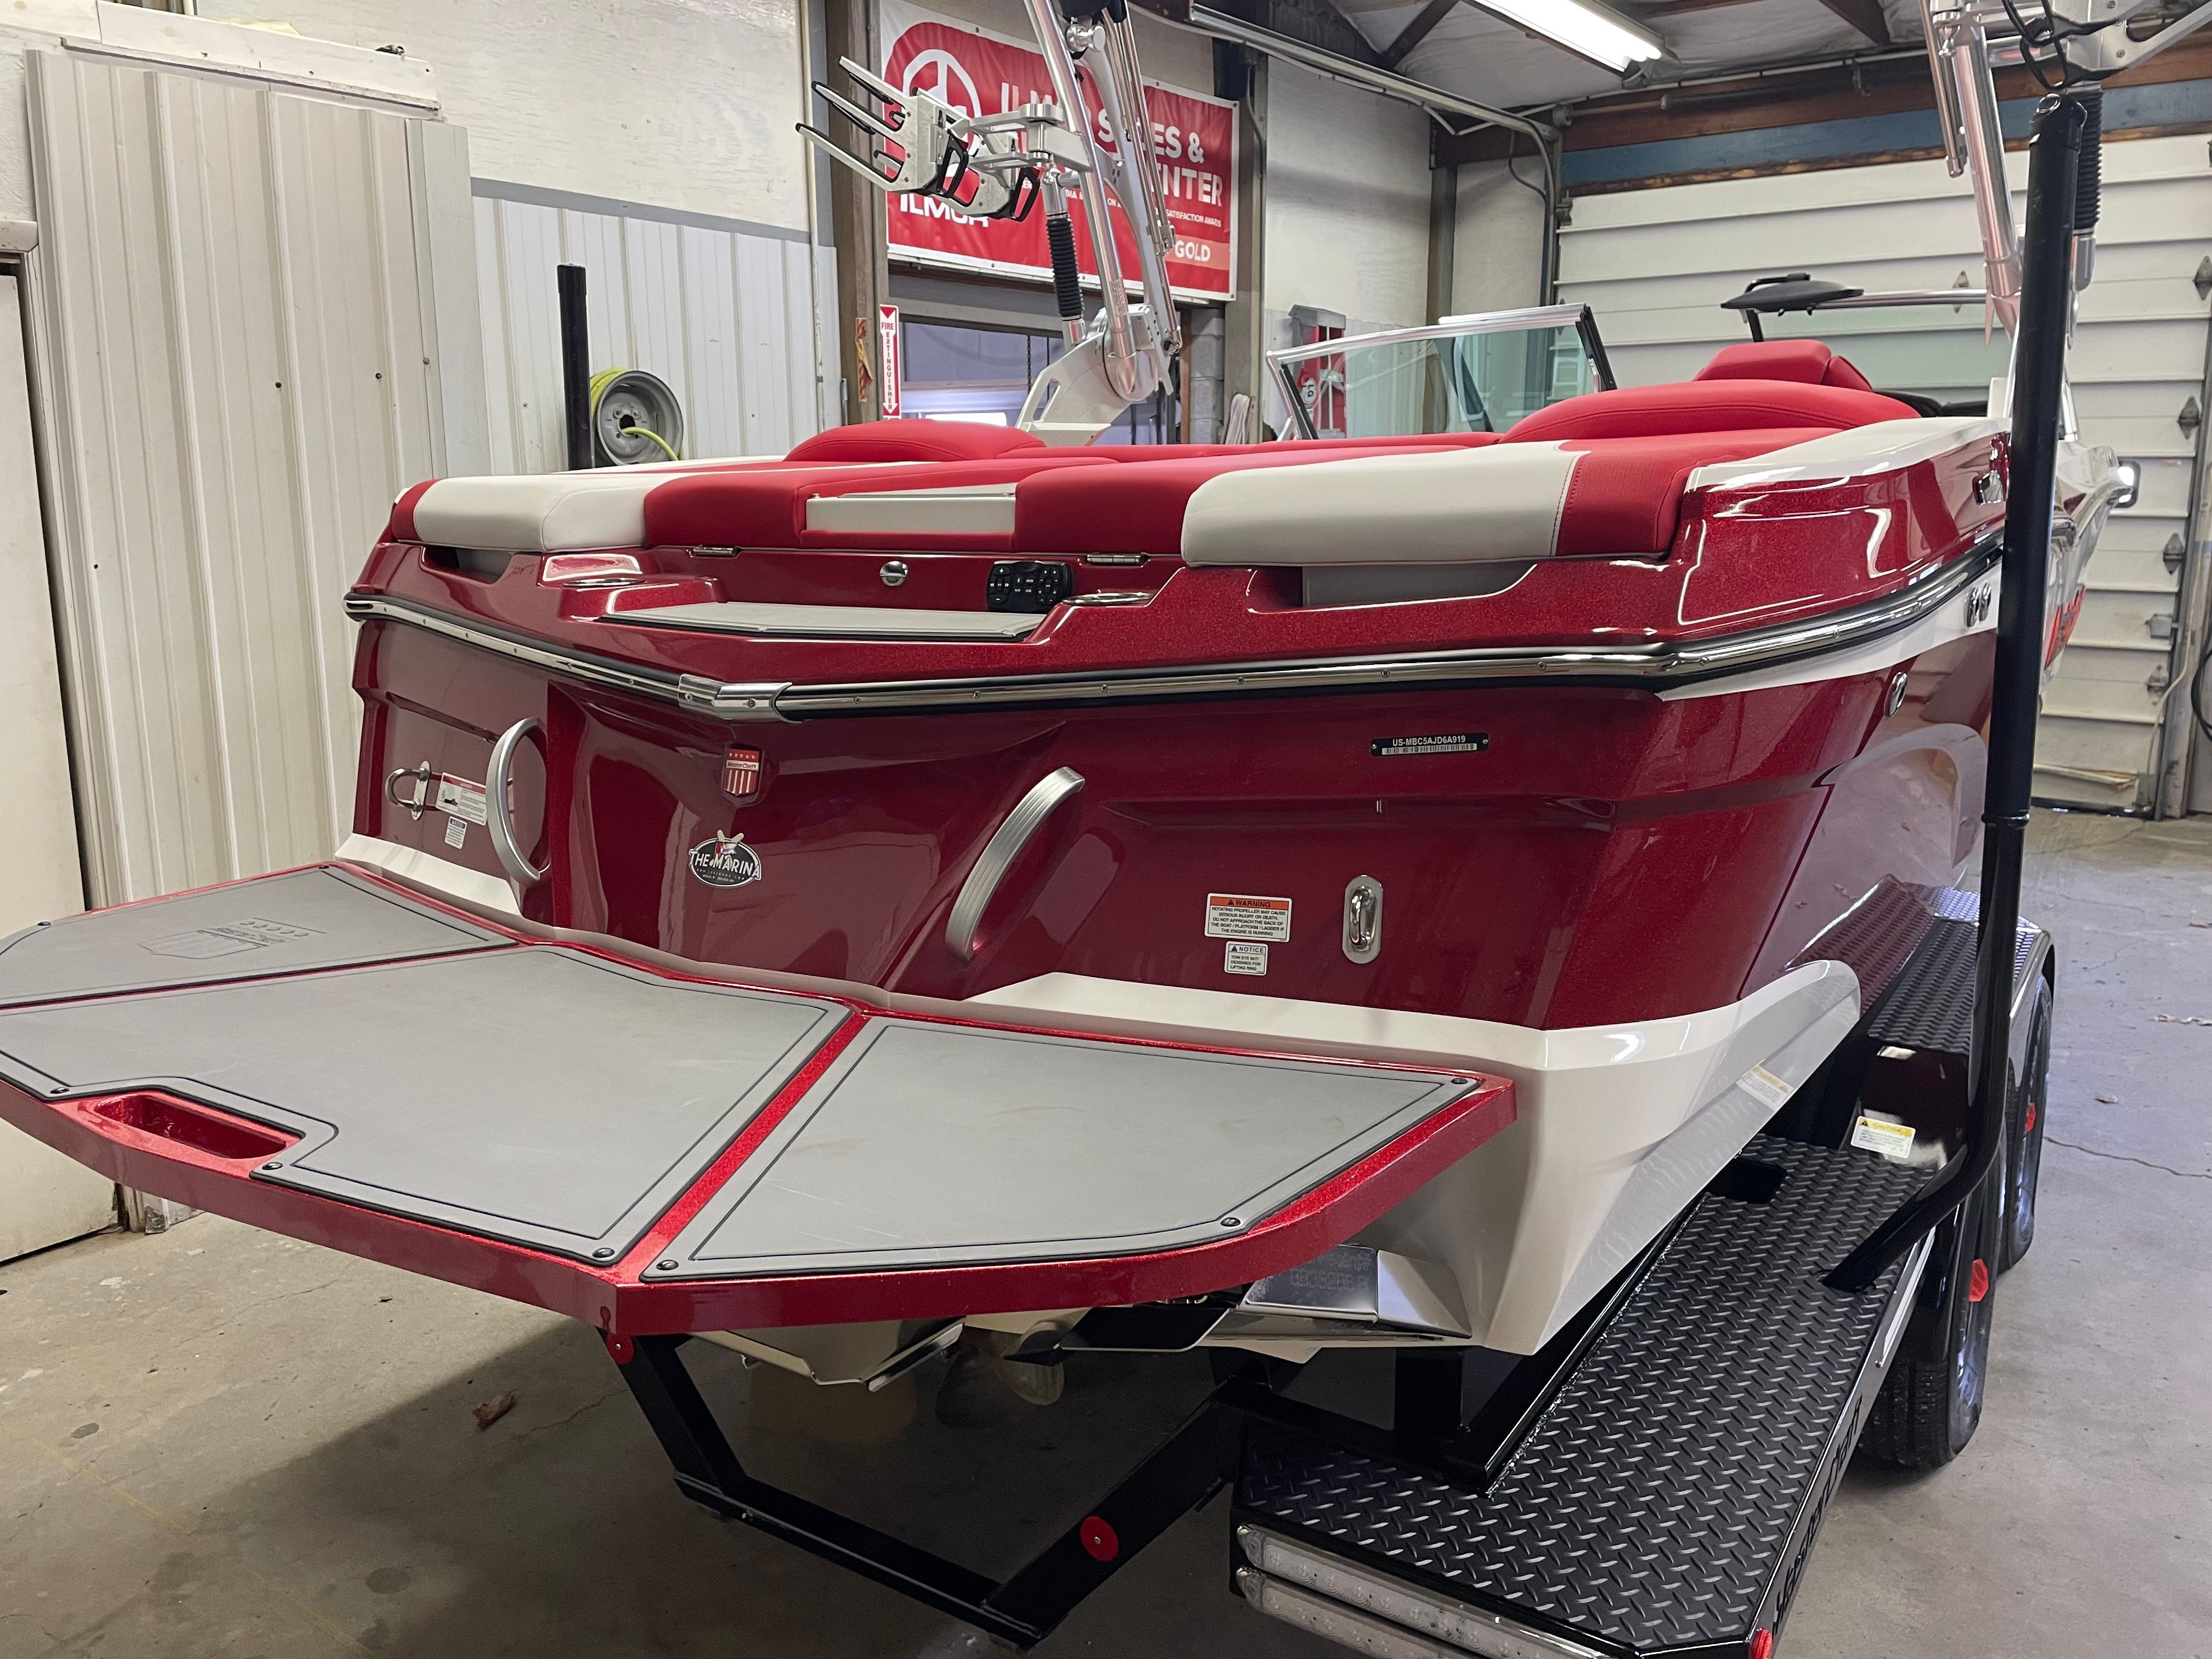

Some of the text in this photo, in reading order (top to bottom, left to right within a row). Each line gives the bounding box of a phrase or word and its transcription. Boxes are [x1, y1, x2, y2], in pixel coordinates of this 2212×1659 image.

[1098, 109, 1204, 163] SES &
[1166, 209, 1204, 222] SATISFACTION
[1175, 240, 1210, 262] GOLD
[1392, 735, 1466, 746] US-MBC5AJD6A919
[690, 851, 710, 867] THE
[713, 853, 759, 878] MARINA
[1235, 899, 1271, 907] WARNING
